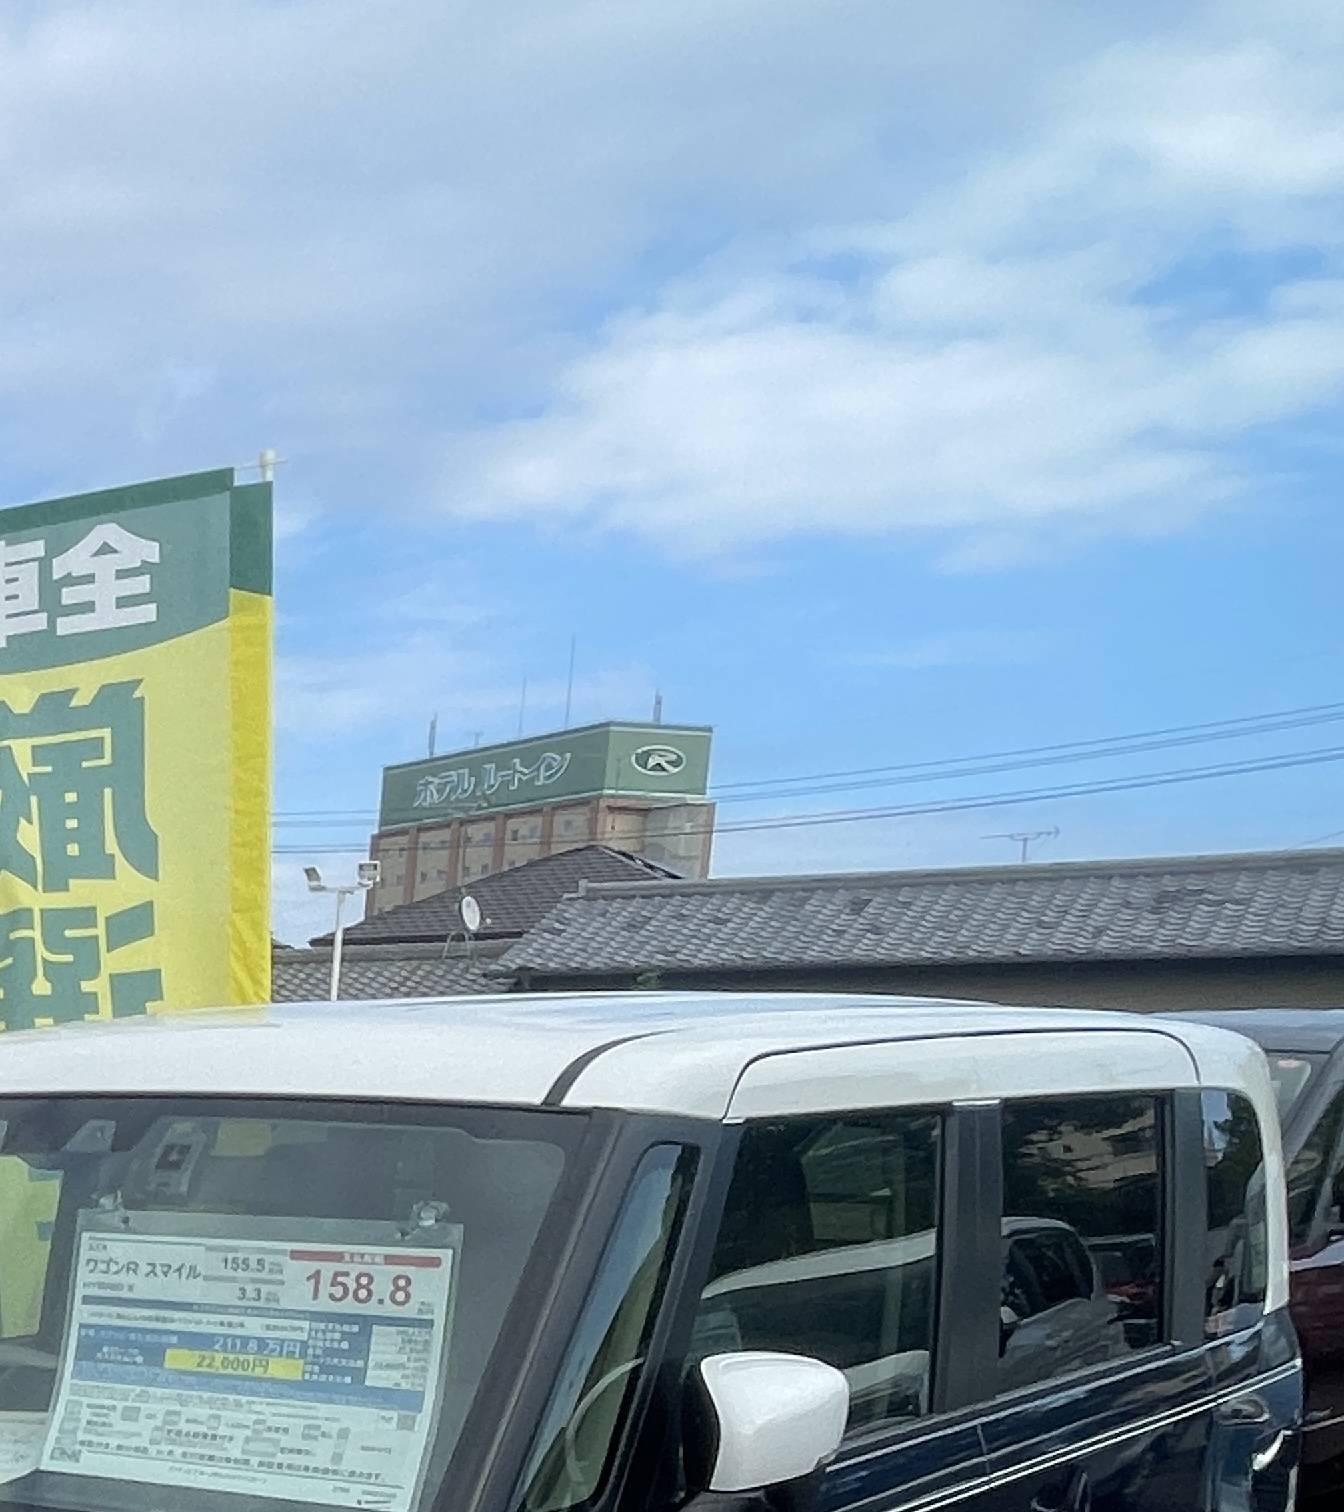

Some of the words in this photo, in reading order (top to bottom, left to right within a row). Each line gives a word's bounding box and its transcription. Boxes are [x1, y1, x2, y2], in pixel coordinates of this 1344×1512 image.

[85, 1257, 140, 1276] ワゴンR
[144, 1262, 202, 1280] スマイル
[237, 1286, 262, 1302] 3.3
[305, 1269, 412, 1306] 158.8
